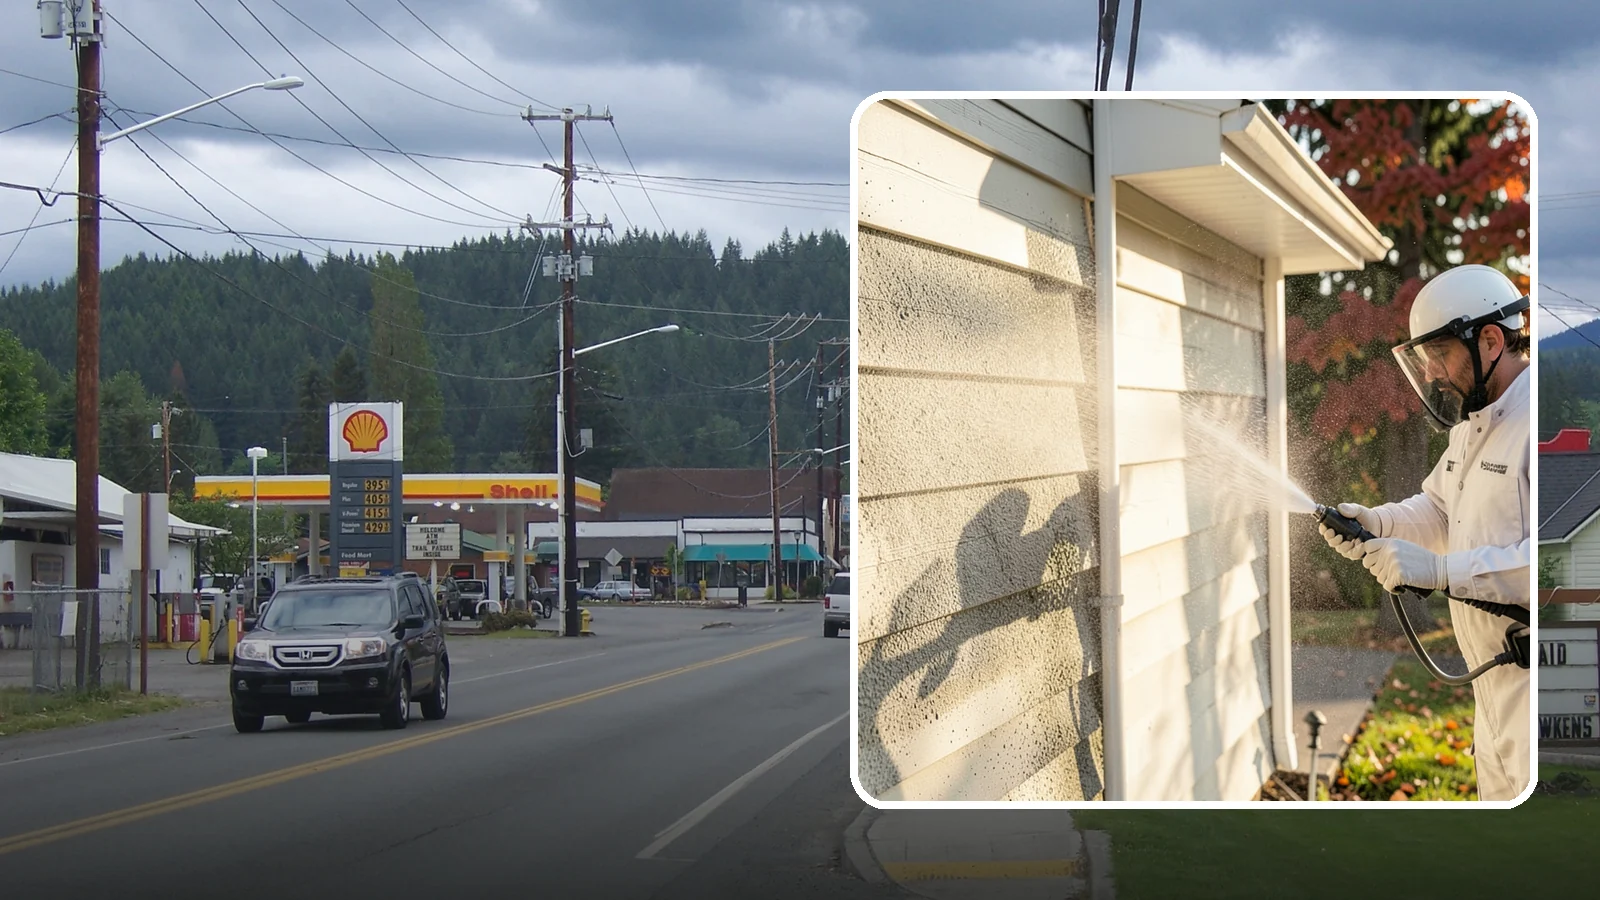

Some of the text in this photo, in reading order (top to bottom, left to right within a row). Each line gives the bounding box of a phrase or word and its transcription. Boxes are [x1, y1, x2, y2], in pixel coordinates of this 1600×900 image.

[366, 480, 383, 490] 395
[490, 484, 547, 499] Shell
[366, 494, 383, 504] 405
[366, 508, 383, 518] 415
[366, 522, 383, 533] 429
